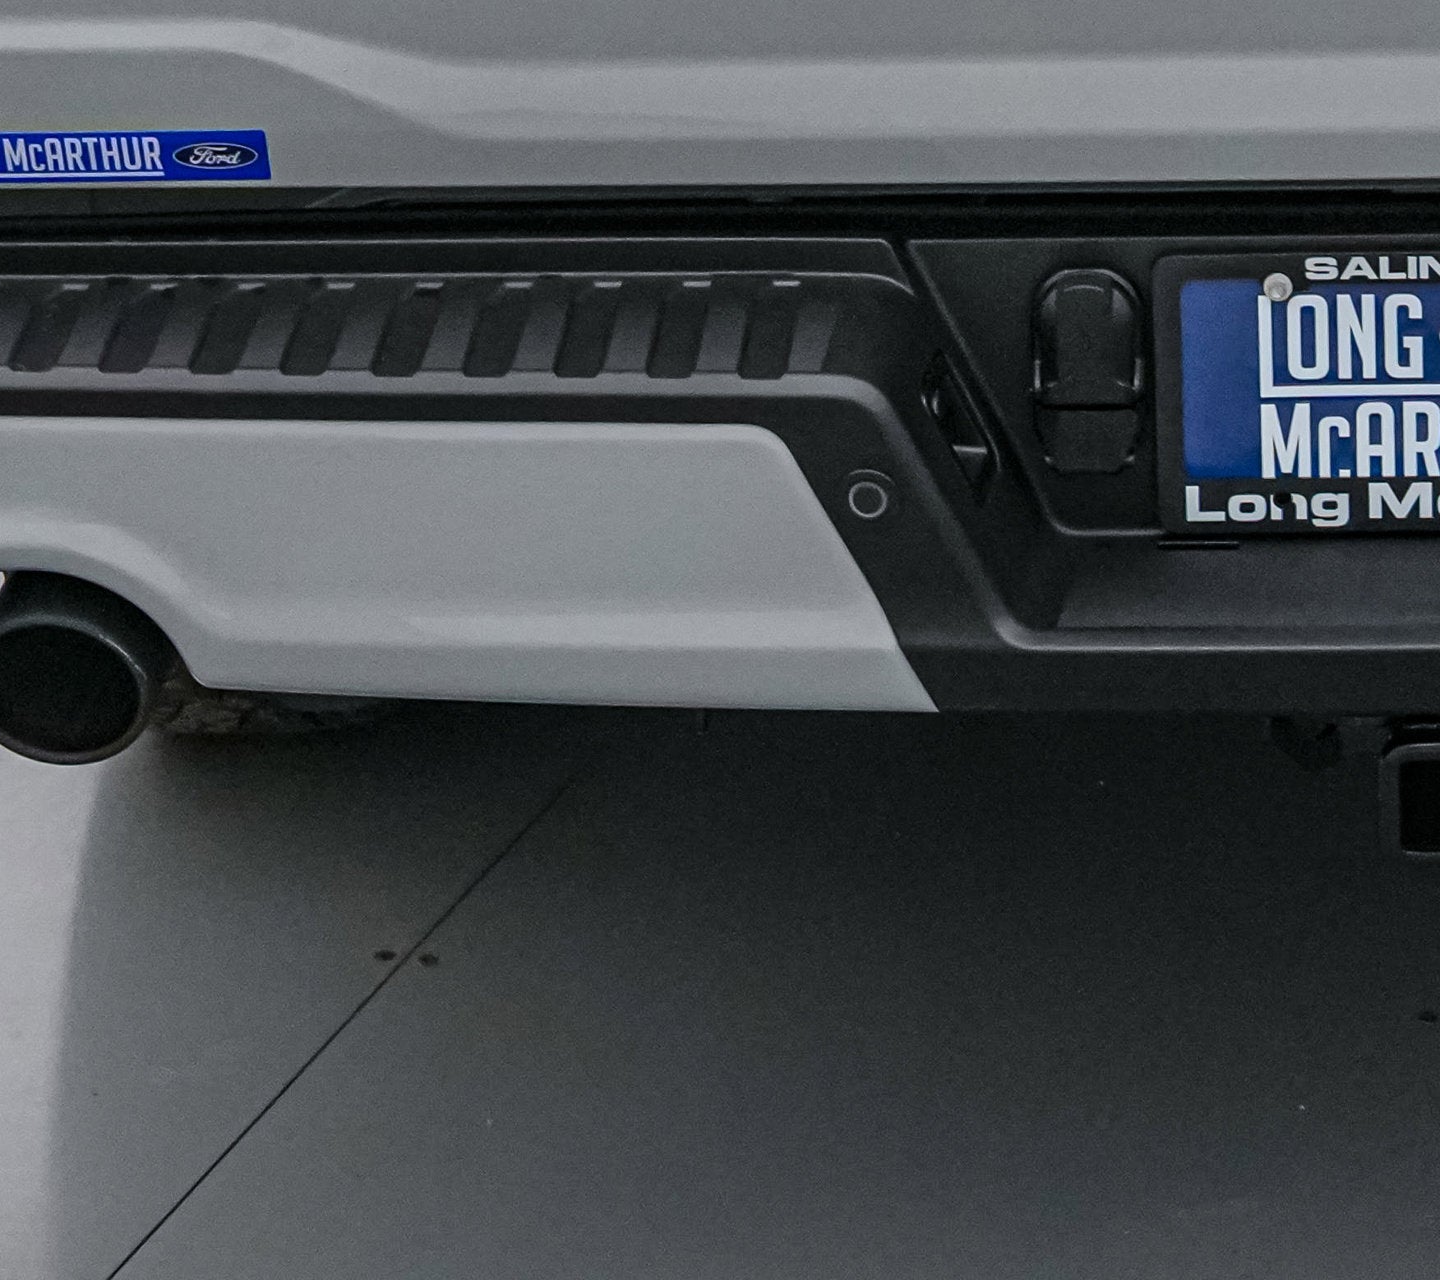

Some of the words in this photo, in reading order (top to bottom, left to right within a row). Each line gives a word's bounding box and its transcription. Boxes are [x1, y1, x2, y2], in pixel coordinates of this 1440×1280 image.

[4, 136, 164, 172] McARTHUR
[188, 146, 242, 165] Ford
[1257, 293, 1425, 397] LONG
[1185, 484, 1351, 528] Long
